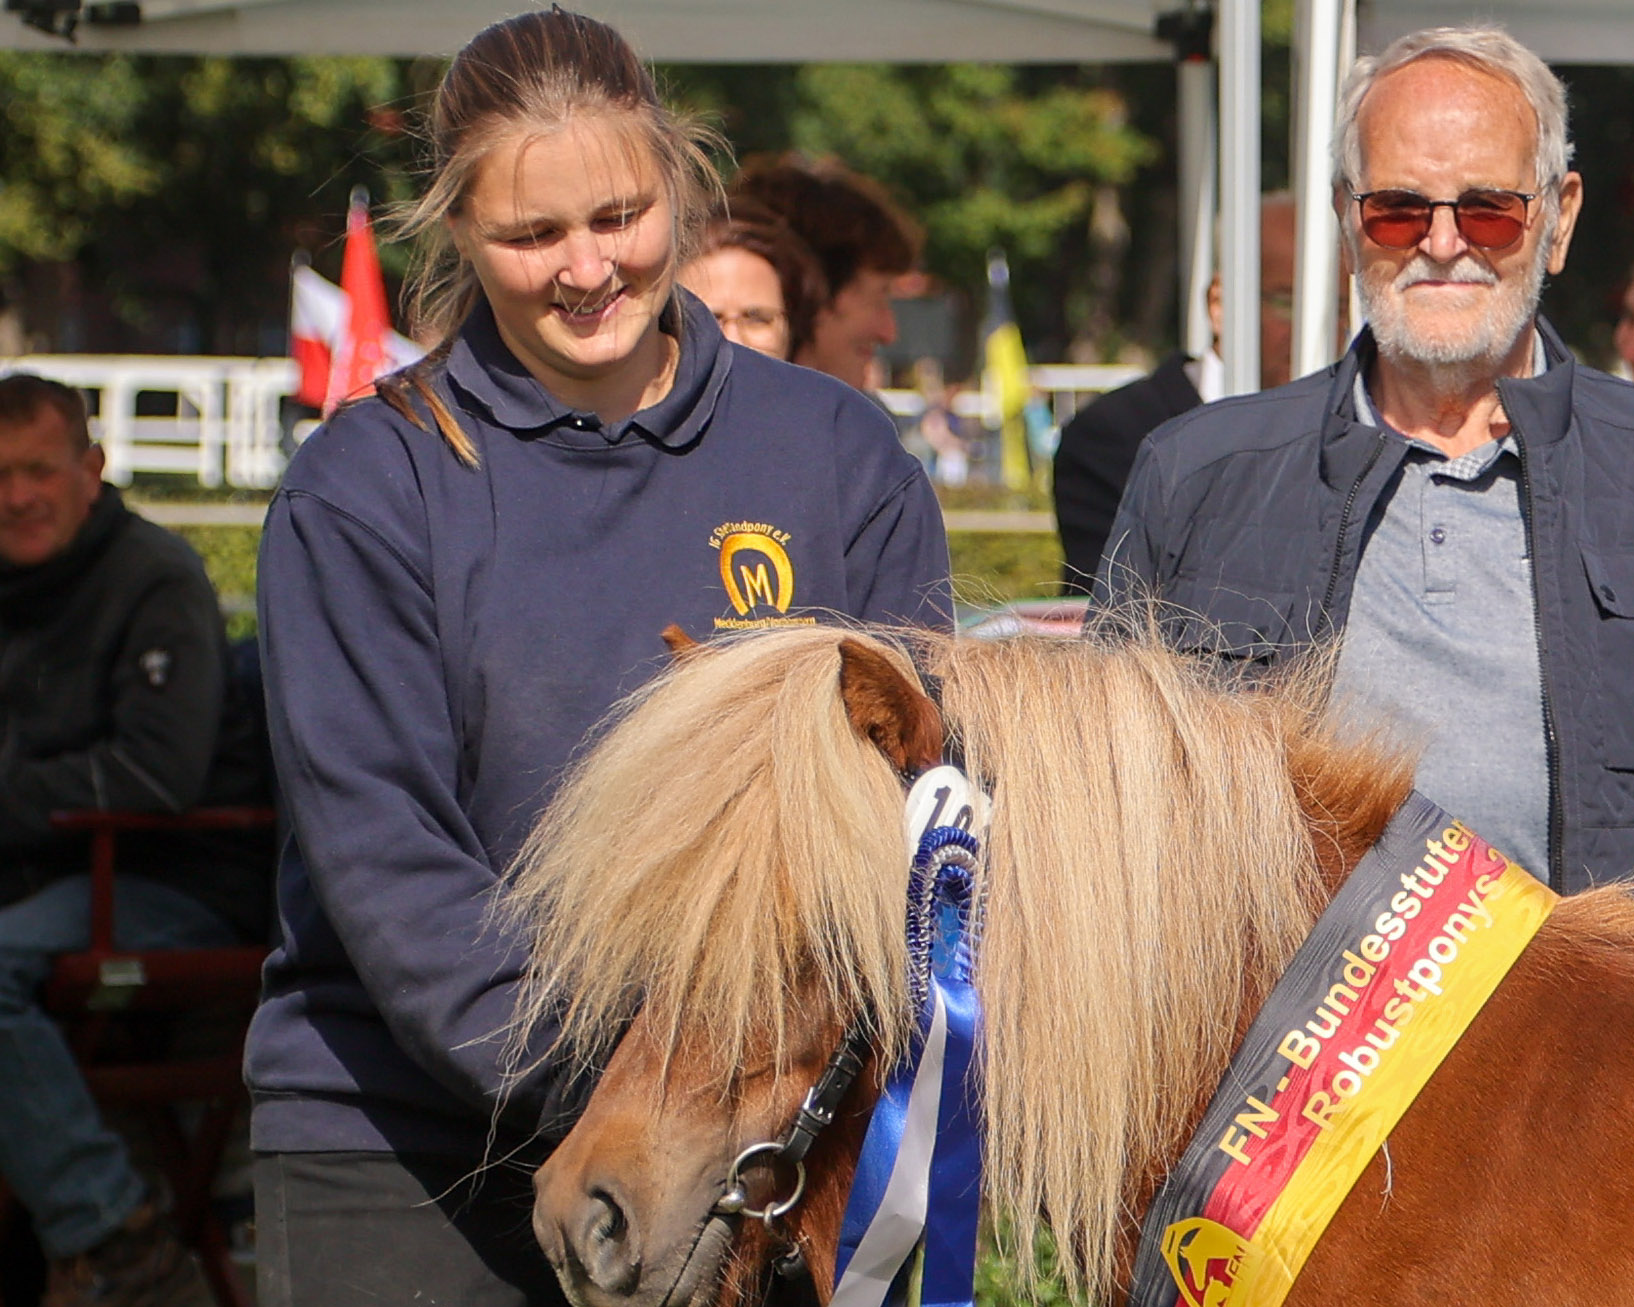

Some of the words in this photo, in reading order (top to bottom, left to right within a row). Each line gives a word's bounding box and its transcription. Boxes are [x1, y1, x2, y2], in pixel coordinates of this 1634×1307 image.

[740, 563, 774, 608] M
[1302, 874, 1505, 1132] Robustponys
[1218, 1095, 1280, 1166] FN
